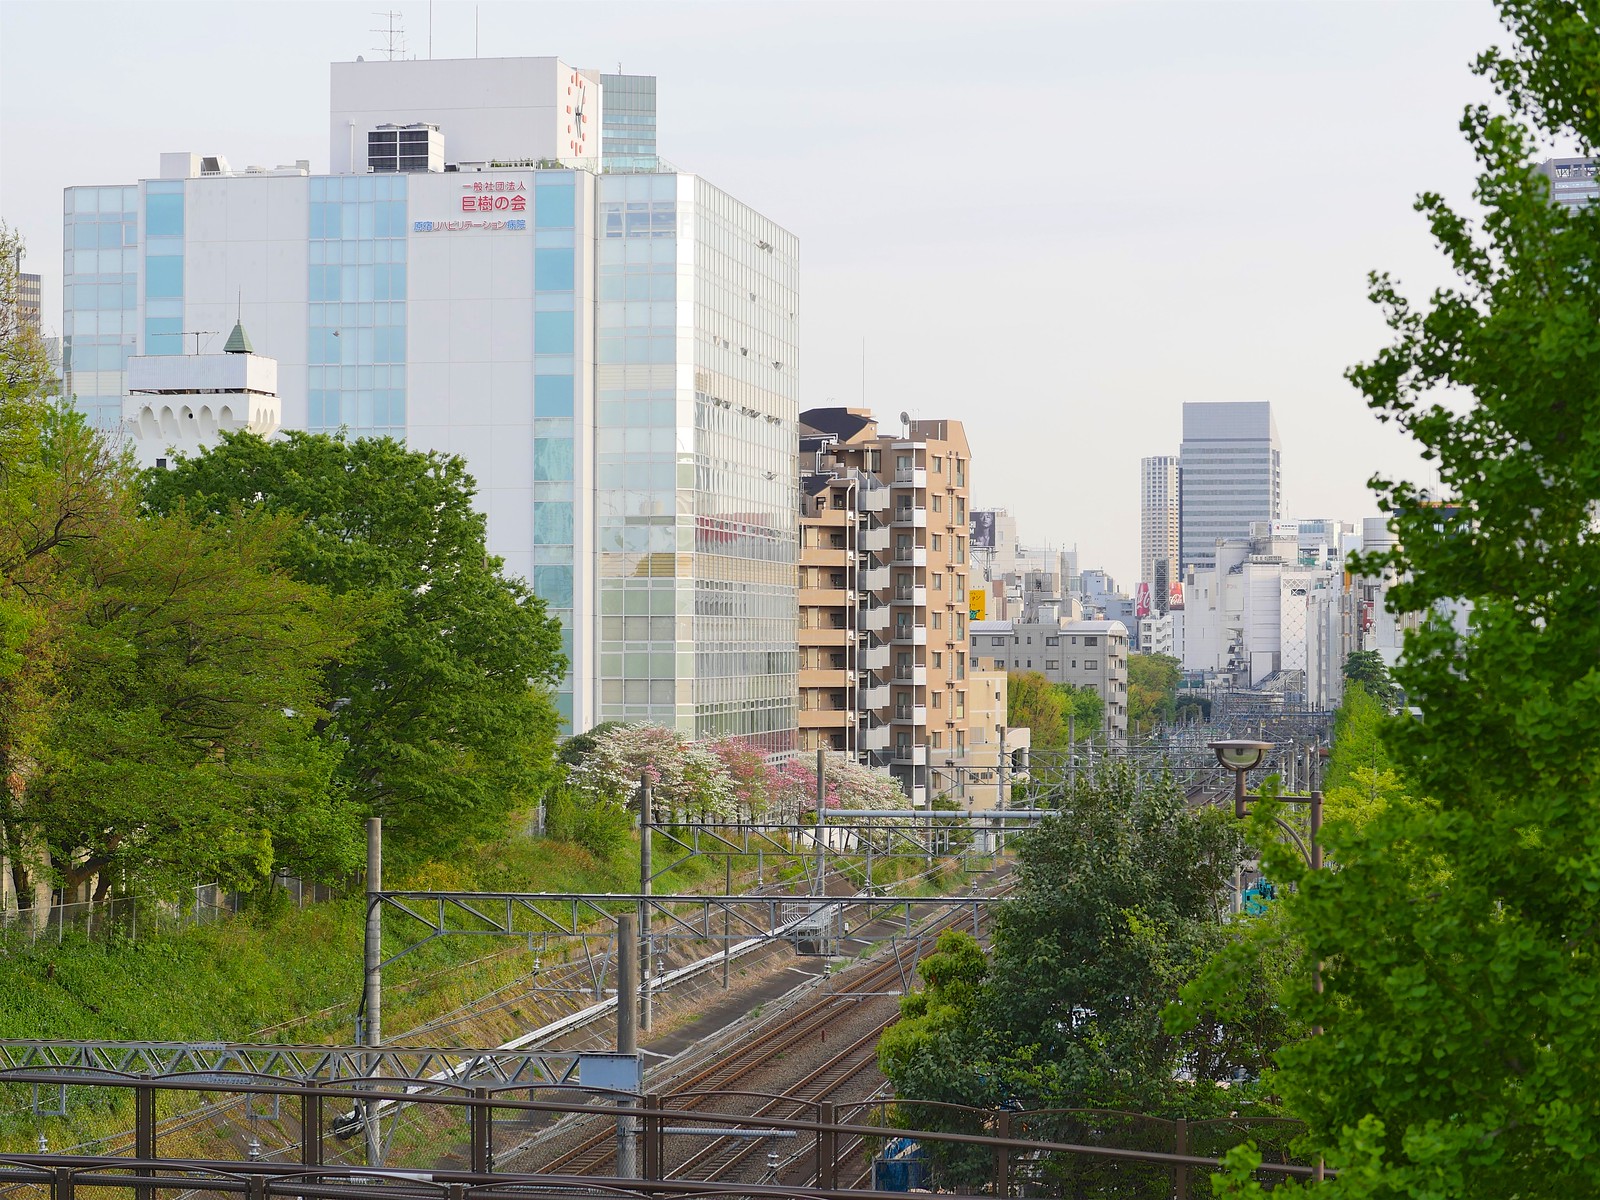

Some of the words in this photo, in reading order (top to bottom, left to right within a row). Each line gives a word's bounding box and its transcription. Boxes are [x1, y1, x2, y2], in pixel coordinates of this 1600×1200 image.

[463, 181, 526, 192] 一般社団法人
[462, 195, 526, 211] 巨樹の会
[414, 220, 526, 232] 原宿リハビリテーション病院
